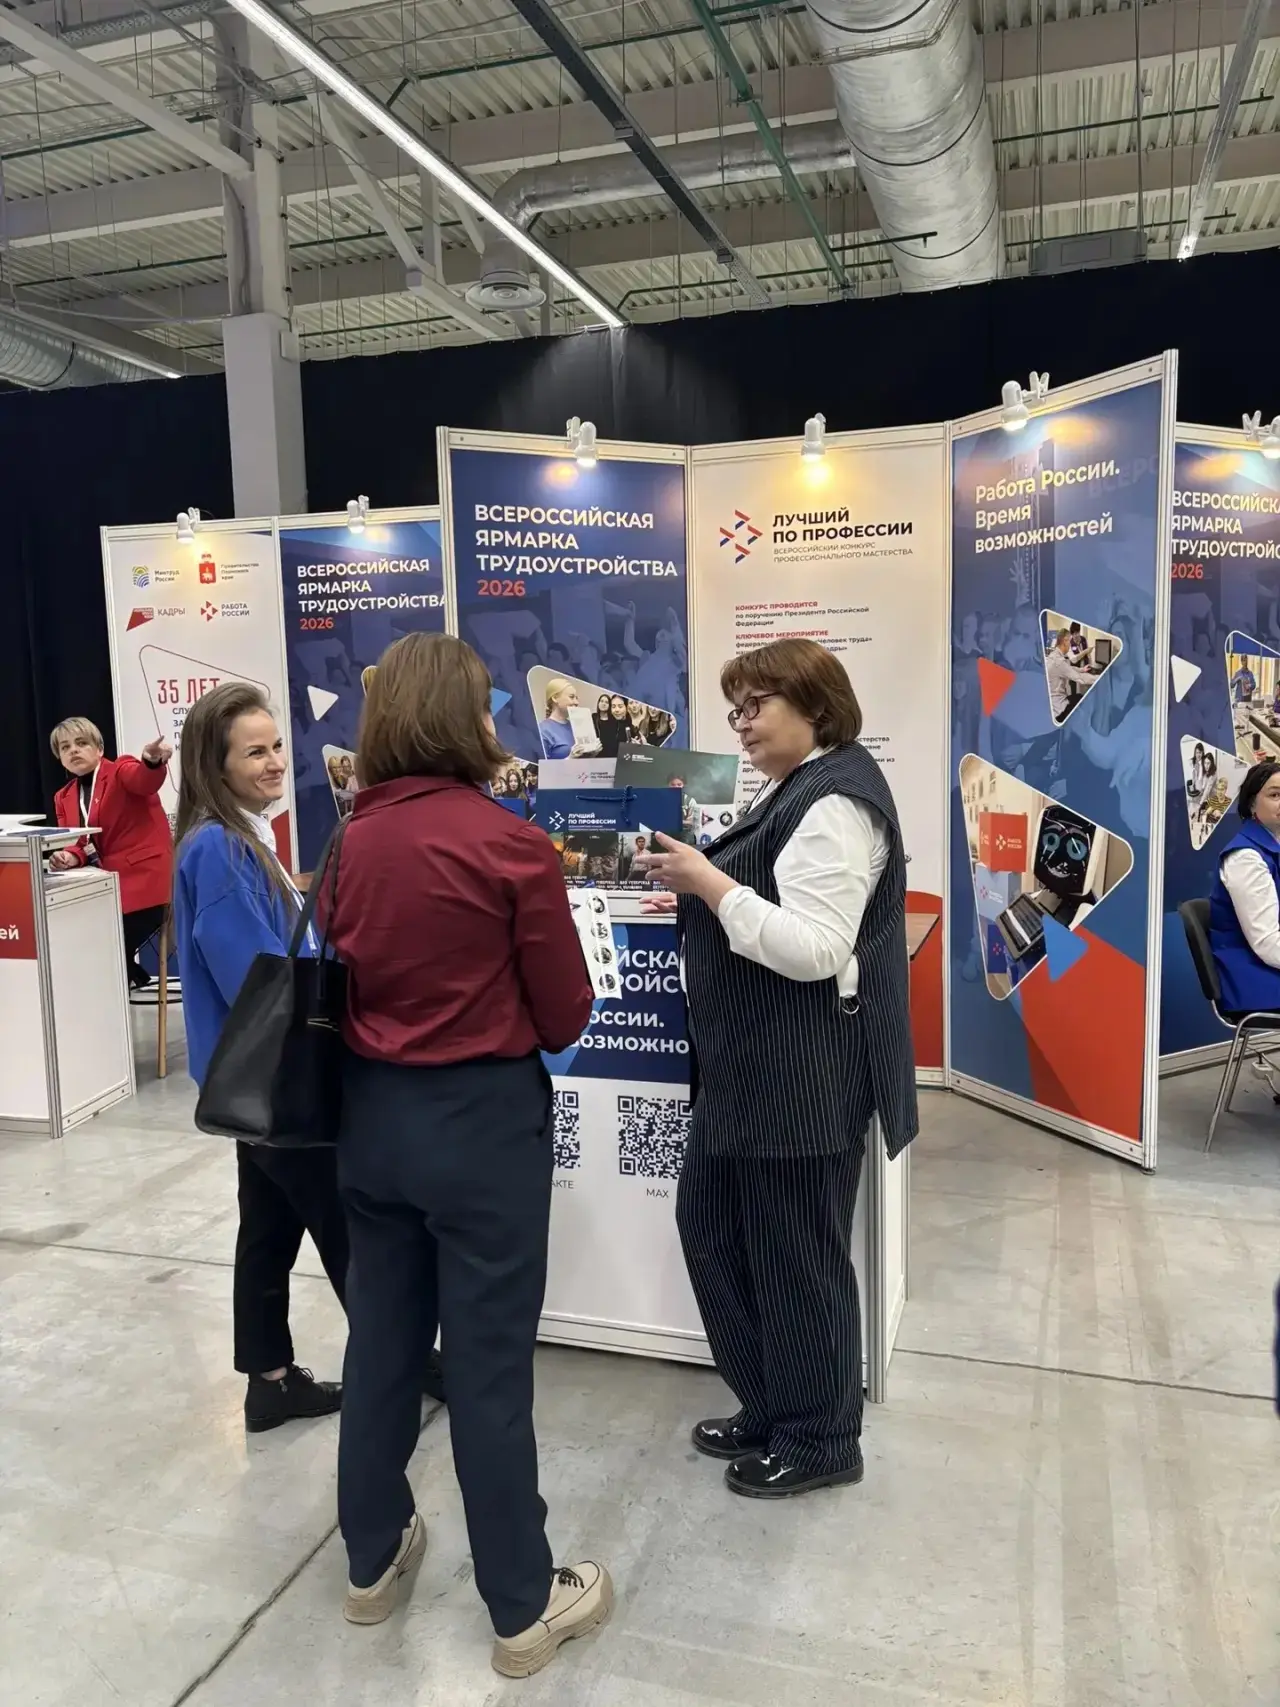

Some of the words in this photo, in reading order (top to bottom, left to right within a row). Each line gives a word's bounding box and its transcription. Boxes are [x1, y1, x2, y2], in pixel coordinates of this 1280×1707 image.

[975, 477, 1036, 504] Работа
[1041, 460, 1120, 490] России.
[475, 504, 654, 529] ВСЕРОССИЙСКАЯ
[772, 506, 850, 527] ЛУЧШИЙ
[975, 504, 1031, 531] Время
[1172, 514, 1243, 534] ЯРМАРКА
[475, 530, 579, 550] ЯРМАРКА
[773, 530, 798, 543] ПО
[802, 522, 913, 542] ПРОФЕССИИ
[975, 512, 1113, 554] возможностей
[774, 544, 839, 554] ВСЕРОССИЙСКИЙ
[840, 542, 876, 550] КОНКУРС
[774, 552, 861, 563] ПРОФЕССИОНАЛЬНОГО
[863, 548, 913, 556] МАСТЕРСТВА
[297, 558, 430, 578] ВСЕРОССИЙСКАЯ
[476, 554, 678, 577] ТРУДОУСТРОЙСТВА
[1171, 562, 1204, 580] 2026
[298, 580, 372, 595] ЯРМАРКА
[477, 580, 526, 596] 2026
[158, 608, 186, 616] КАДРЫ
[770, 601, 818, 609] ПРОВОДИТСЯ
[300, 617, 334, 630] 2026
[776, 630, 828, 638] МЕРОПРИЯТИЕ
[157, 679, 179, 704] 35
[619, 970, 680, 993] ОЙС
[571, 1035, 690, 1054] озможно
[646, 1188, 669, 1198] MAX
